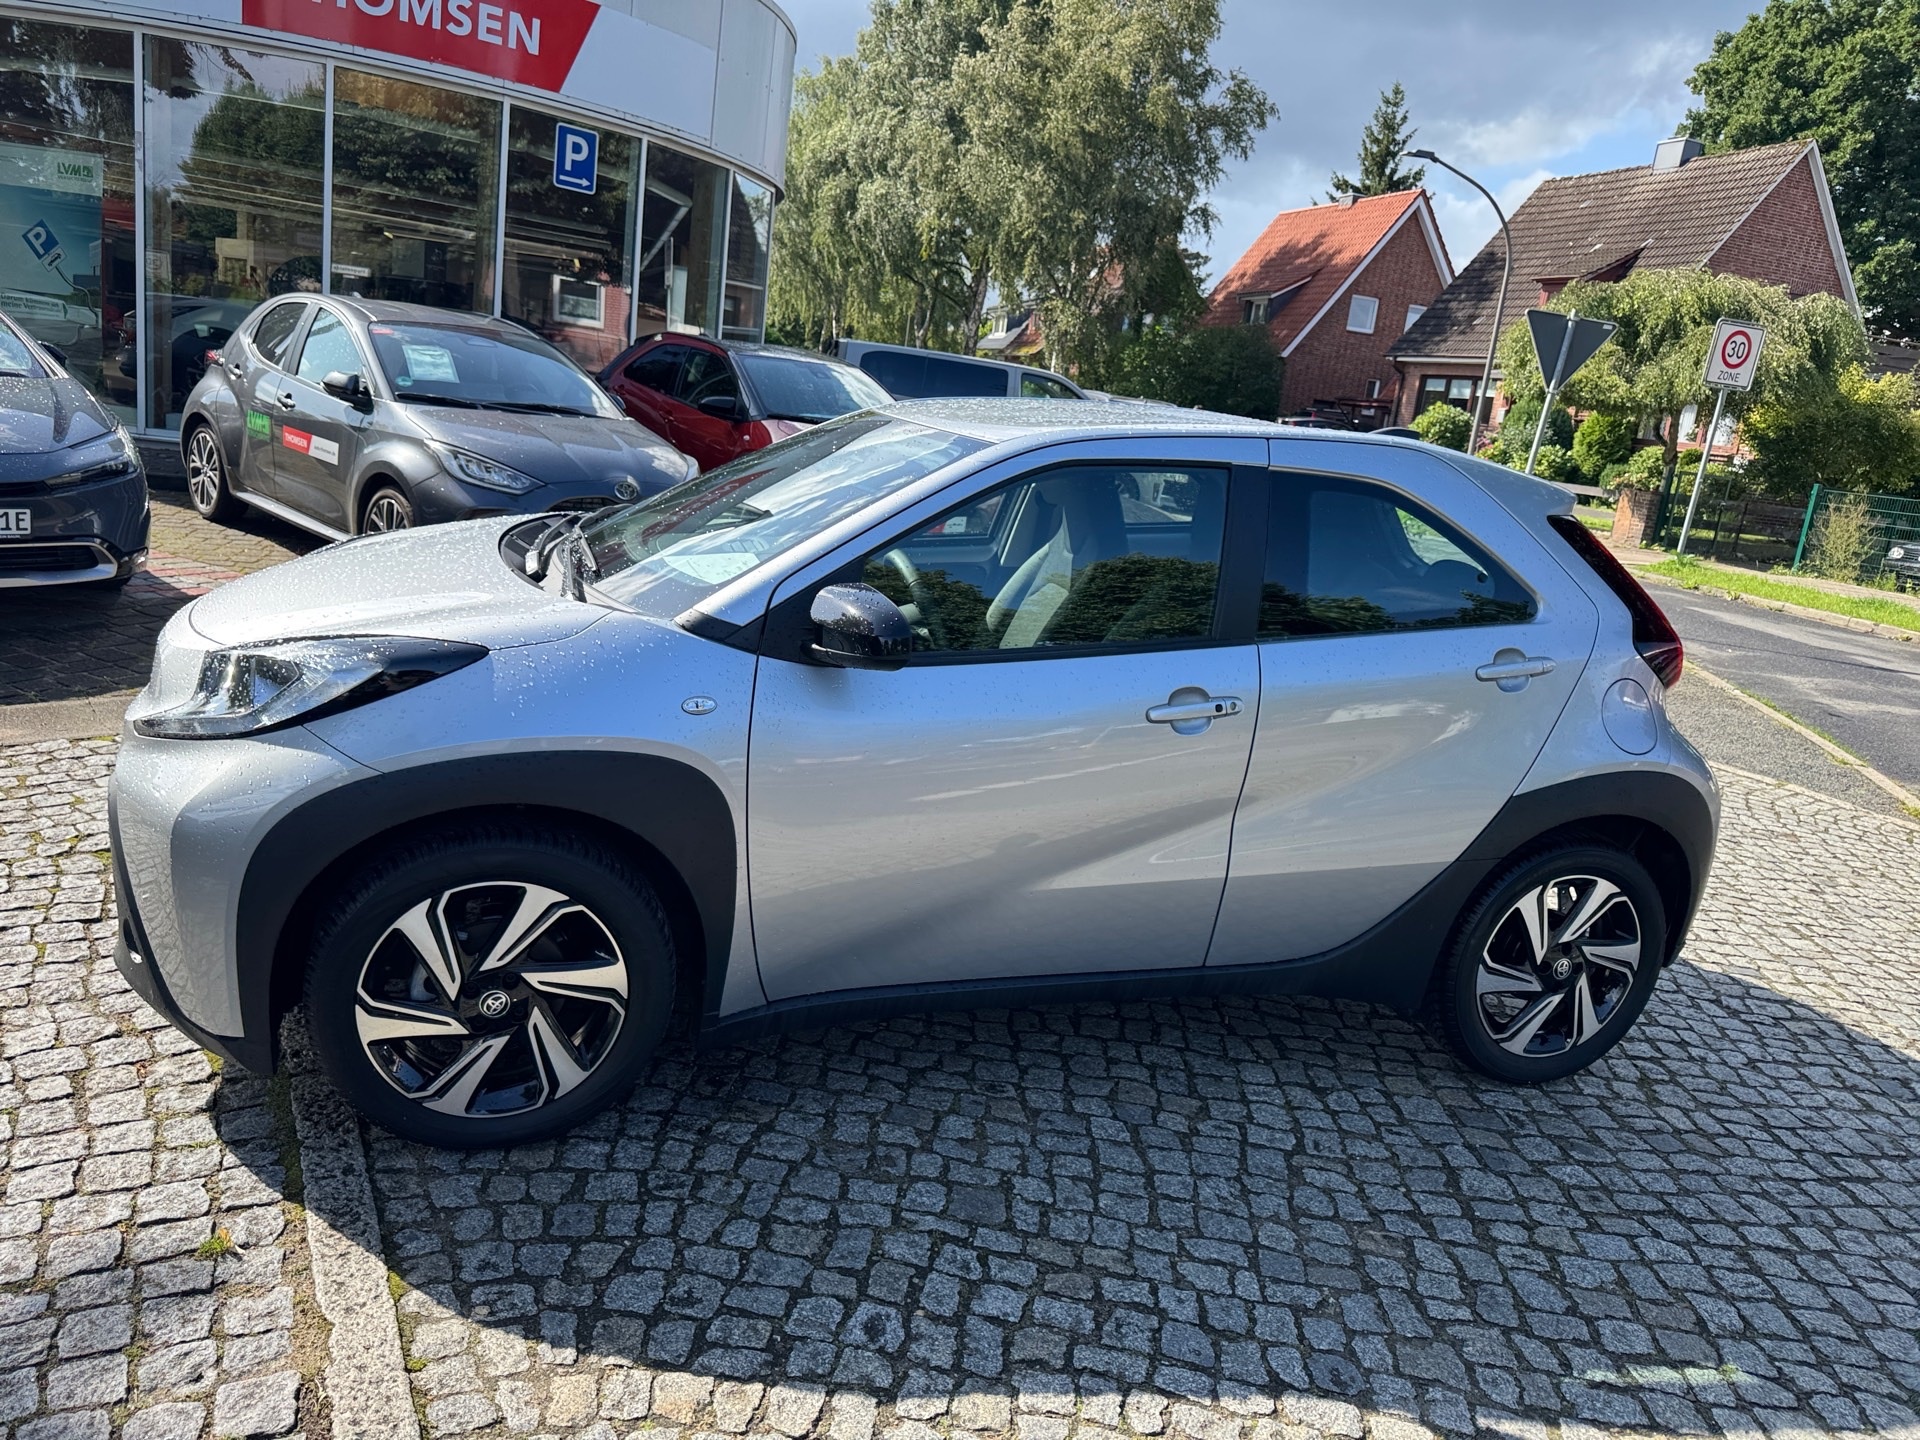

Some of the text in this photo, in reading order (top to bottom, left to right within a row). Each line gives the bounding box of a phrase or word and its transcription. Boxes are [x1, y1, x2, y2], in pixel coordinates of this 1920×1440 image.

[311, 0, 541, 56] MSEN
[564, 133, 589, 171] P
[57, 162, 82, 177] LVM
[27, 226, 47, 255] P
[1727, 340, 1746, 359] 30
[1717, 370, 1741, 383] ZONE
